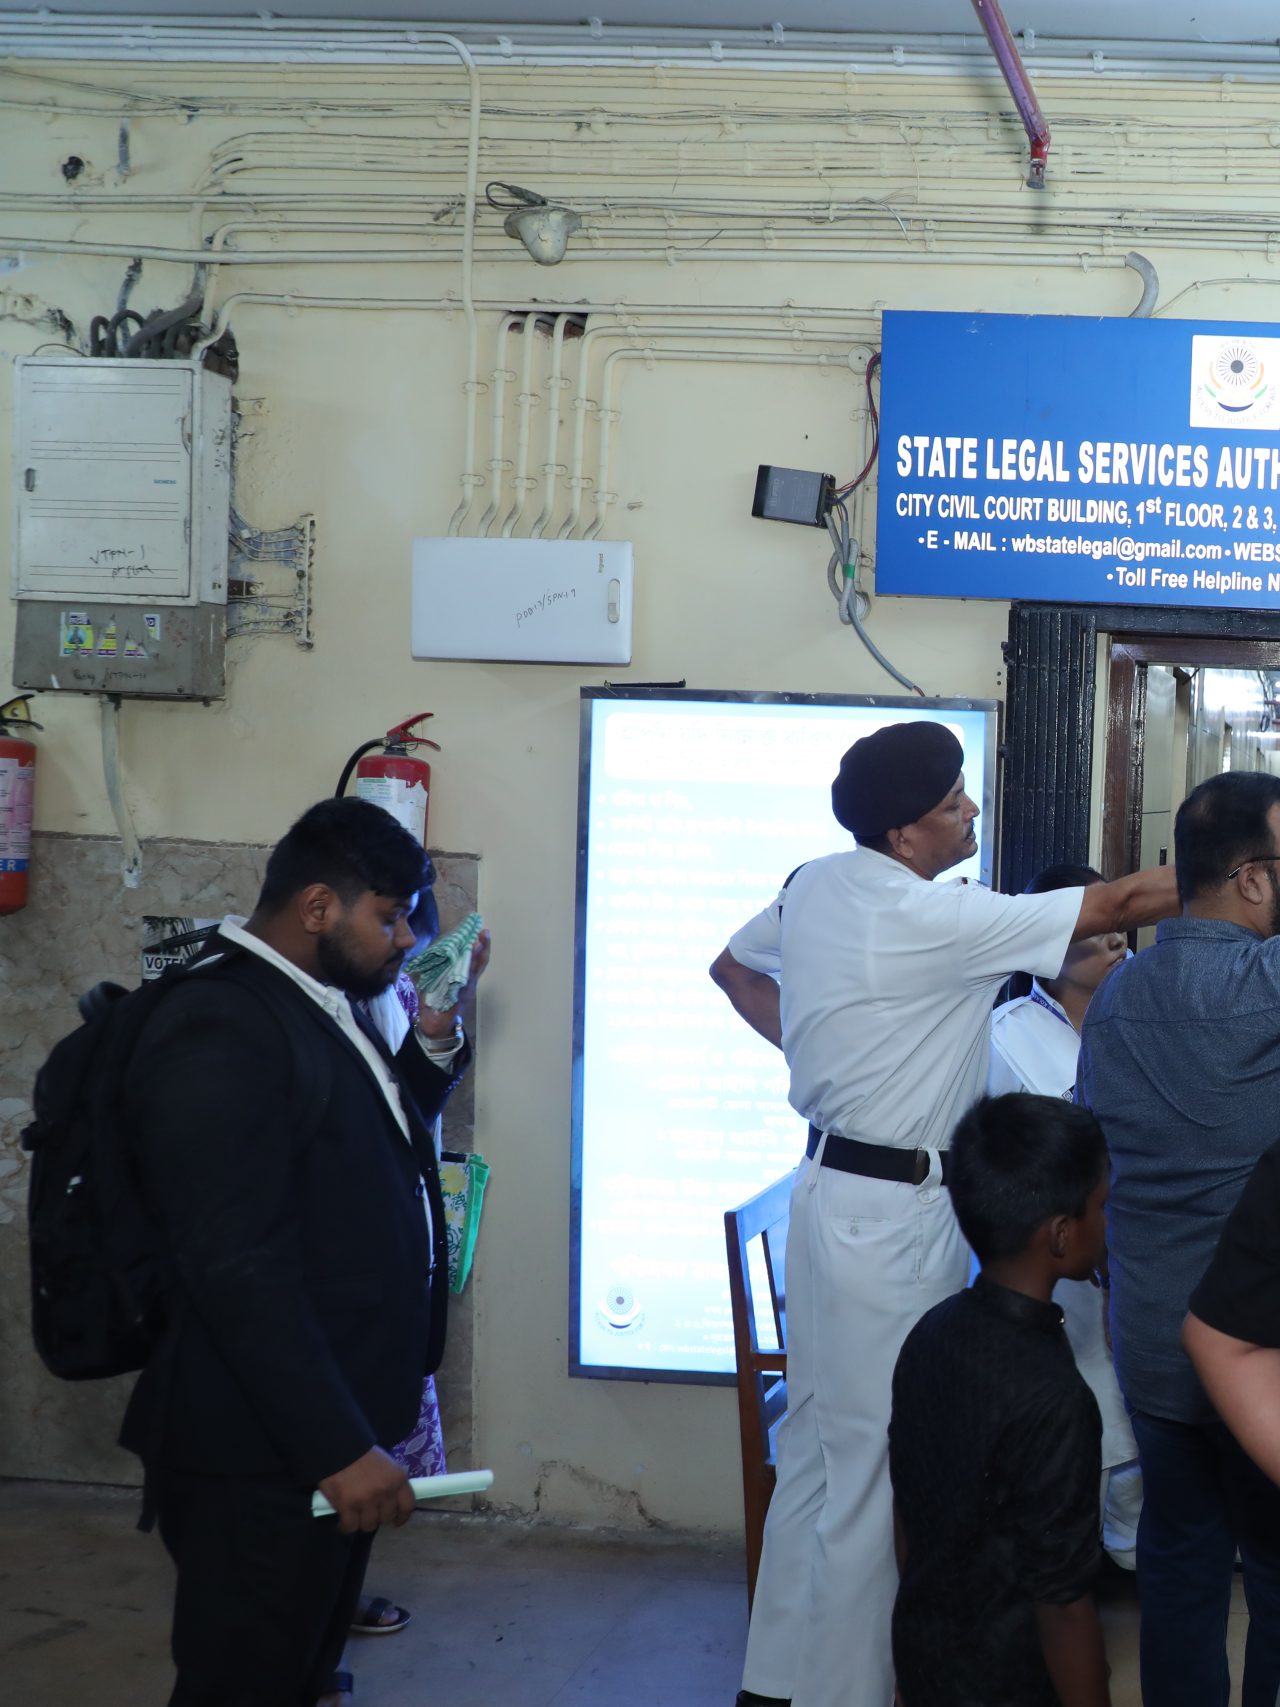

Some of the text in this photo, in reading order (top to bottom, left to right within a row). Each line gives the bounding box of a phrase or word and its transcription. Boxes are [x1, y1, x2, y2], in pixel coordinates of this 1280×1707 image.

[896, 434, 978, 479] STATE
[985, 438, 1071, 483] LEGAL
[1077, 440, 1209, 489] SERVICES
[895, 492, 935, 517] CITY
[937, 494, 981, 519] CIVIL
[983, 495, 1045, 521] COURT
[1047, 497, 1132, 529] BUILDING,
[1135, 496, 1162, 525] 1st
[1164, 502, 1229, 532] FLOOR,
[1231, 504, 1243, 529] 2
[1245, 504, 1260, 530] &
[1262, 505, 1278, 535] 3,
[953, 530, 997, 552] MAIL
[1011, 533, 1223, 562] wbstatelegal@gmail.com
[1115, 566, 1147, 587] Toll
[1150, 567, 1189, 589] Free
[1192, 569, 1263, 595] Helpline
